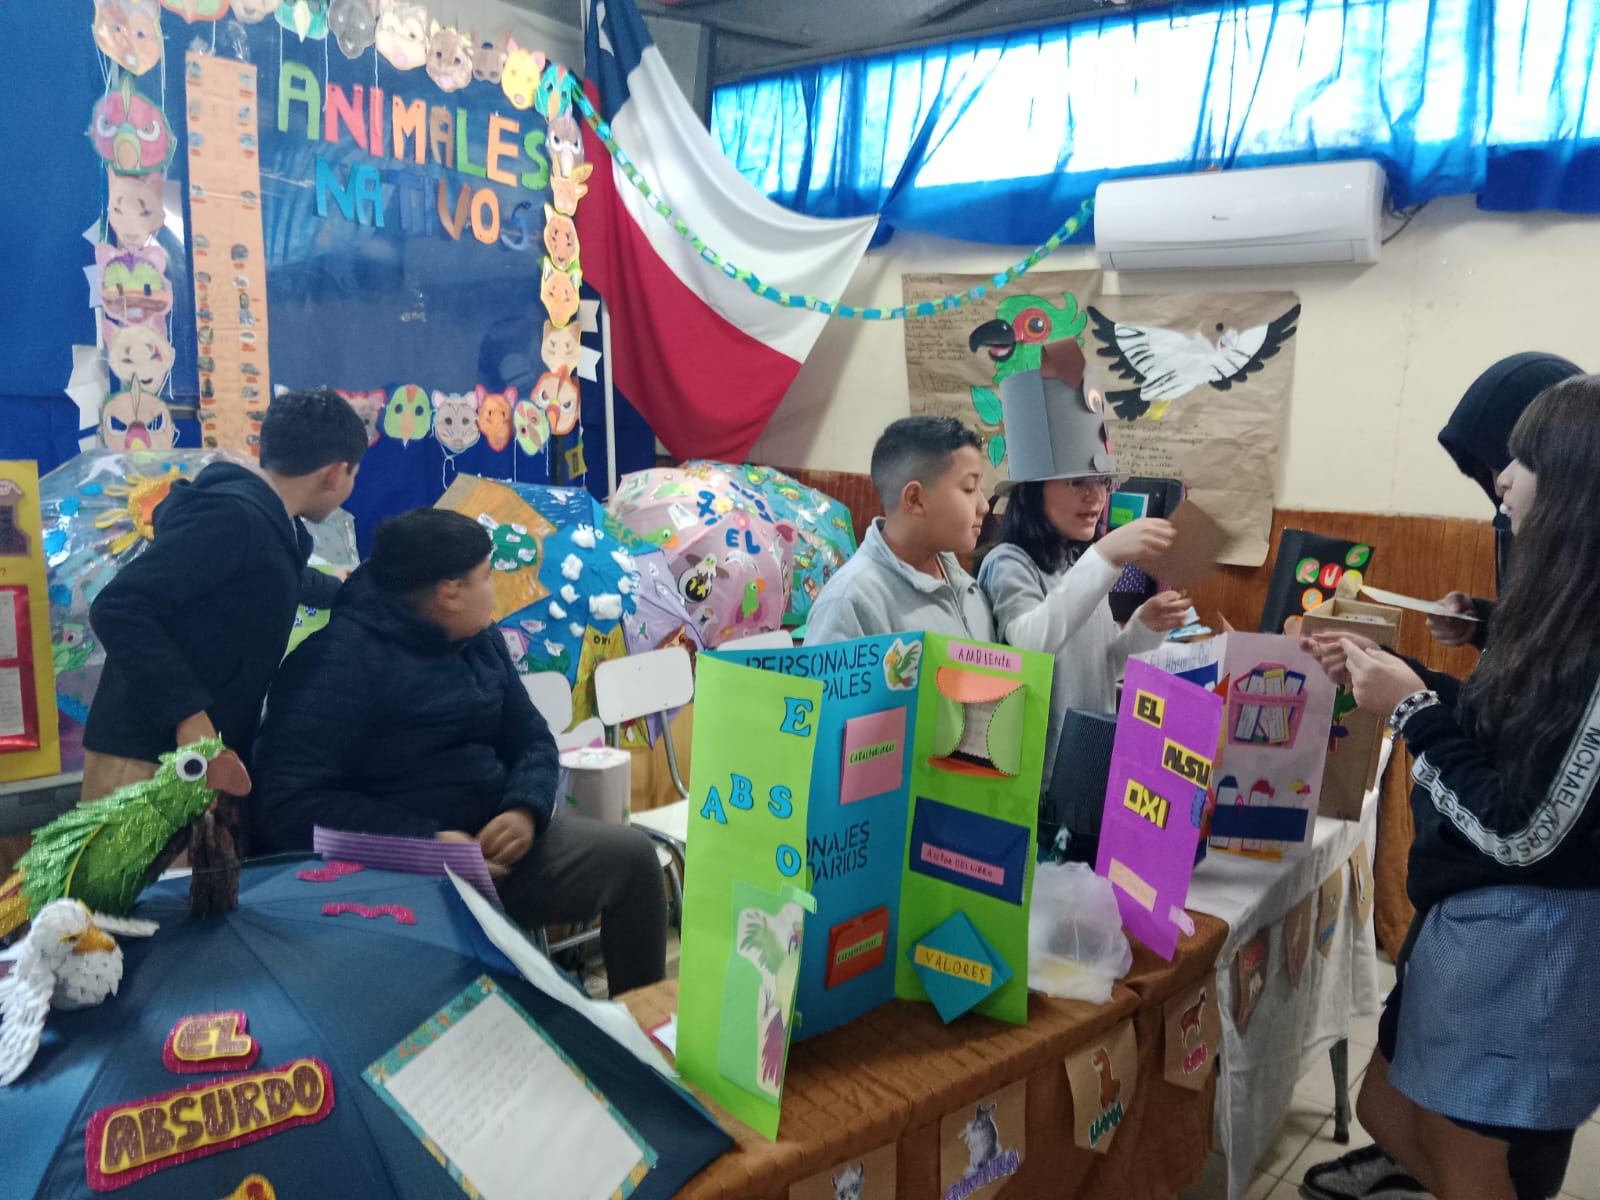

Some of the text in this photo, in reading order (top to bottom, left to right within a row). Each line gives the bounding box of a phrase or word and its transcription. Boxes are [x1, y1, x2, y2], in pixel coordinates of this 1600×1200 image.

[278, 61, 549, 191] ANIMALES
[315, 155, 532, 251] NATIVOS
[725, 528, 761, 554] EL
[1137, 694, 1161, 726] EL
[1556, 726, 1600, 809] MICHAEL
[1123, 779, 1167, 830] OXI
[924, 951, 987, 981] VALORES
[177, 1016, 251, 1056] EL
[103, 1064, 321, 1169] ABSURDO
